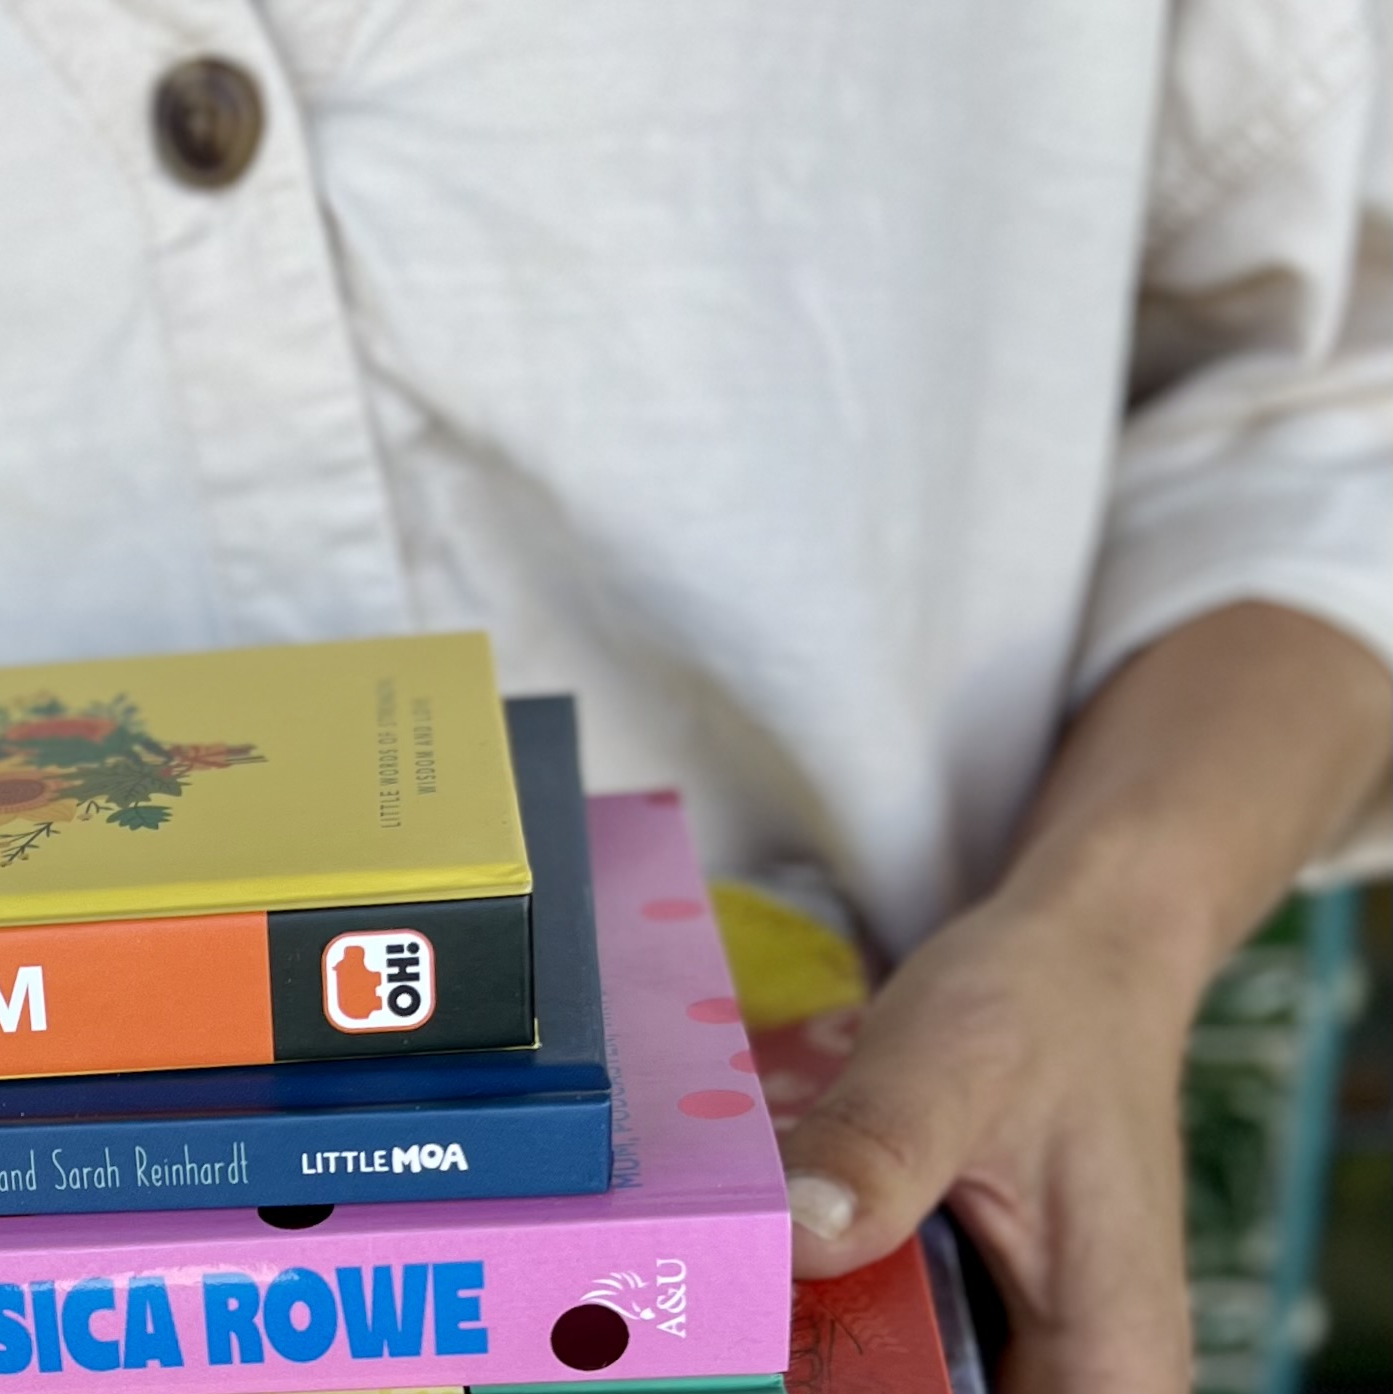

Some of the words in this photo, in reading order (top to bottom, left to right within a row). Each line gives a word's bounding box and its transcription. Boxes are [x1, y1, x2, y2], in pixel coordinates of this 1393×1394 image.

[377, 732, 398, 745] OF
[413, 726, 434, 746] AND
[378, 749, 399, 786] WORDS
[415, 751, 437, 795] WISDOM
[380, 790, 401, 828] LITTLE
[51, 1147, 121, 1189] Sarah
[135, 1141, 249, 1187] Reinhardt
[201, 1260, 490, 1366] ROWE
[656, 1258, 687, 1339] A&U
